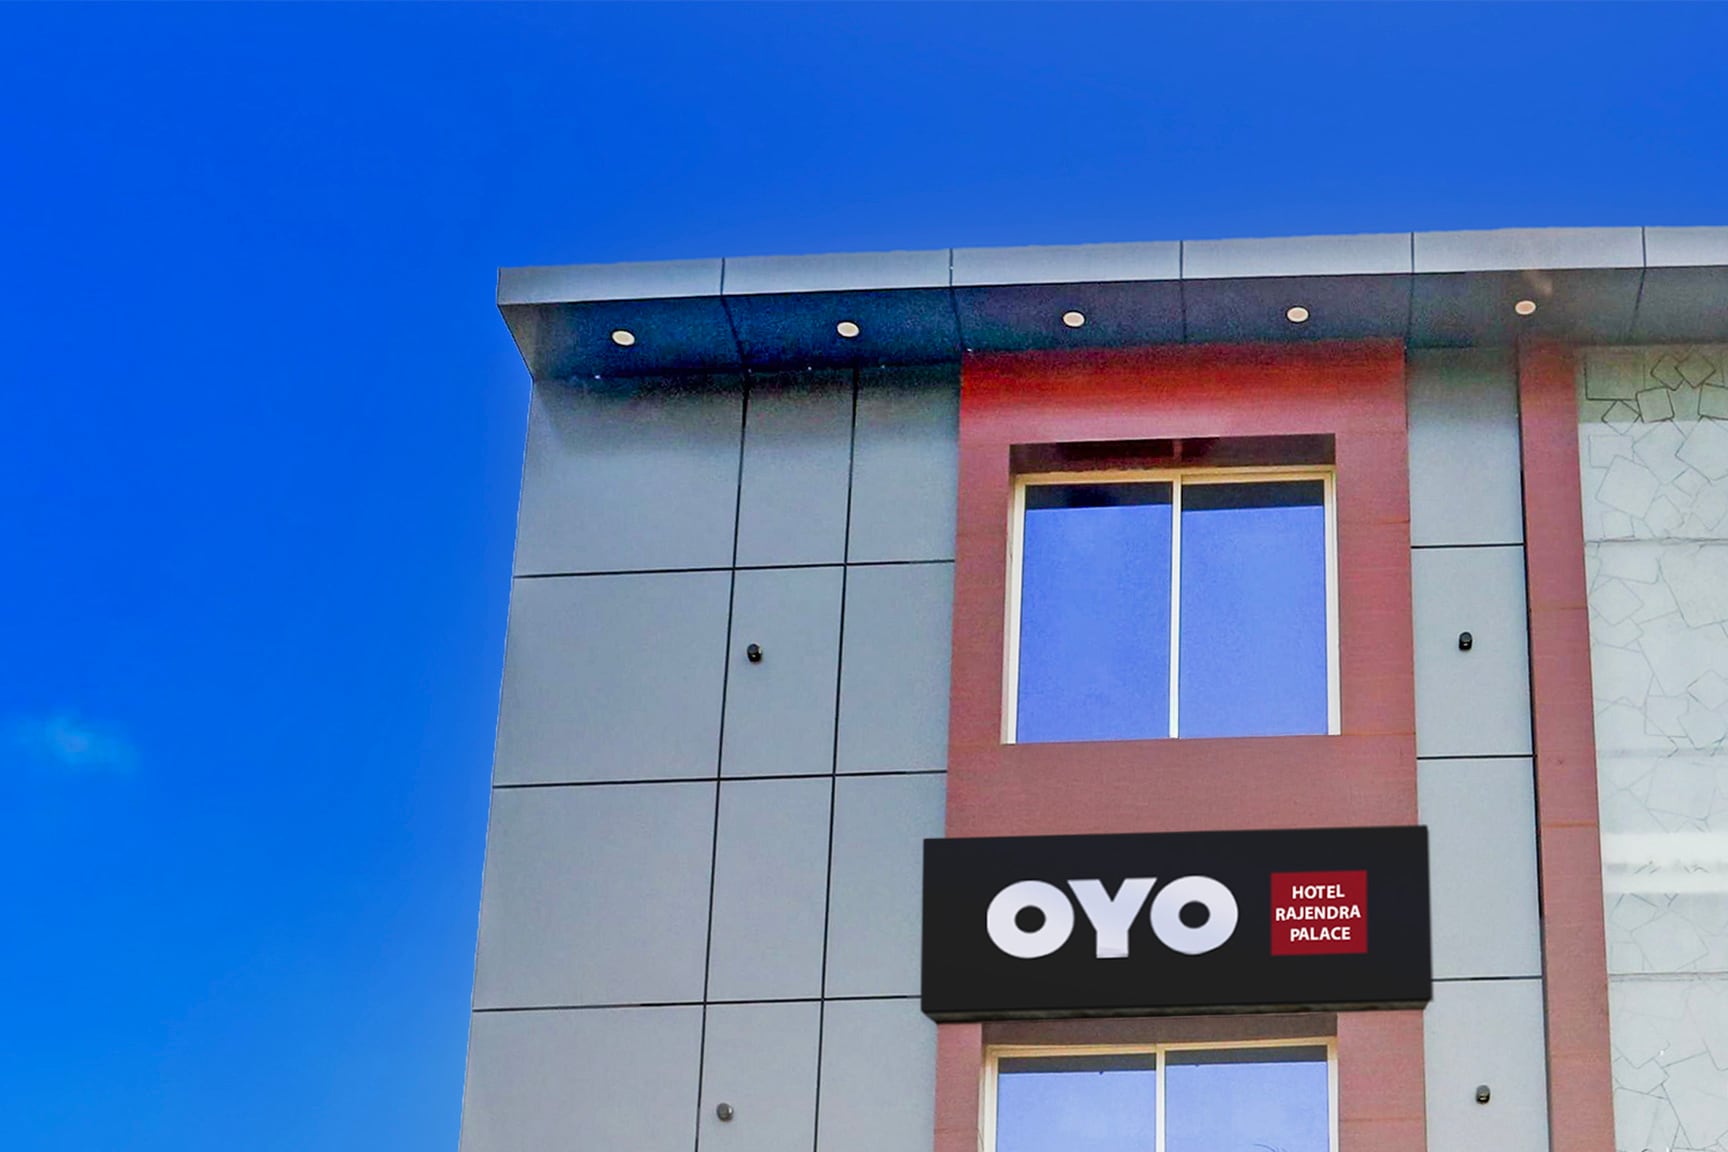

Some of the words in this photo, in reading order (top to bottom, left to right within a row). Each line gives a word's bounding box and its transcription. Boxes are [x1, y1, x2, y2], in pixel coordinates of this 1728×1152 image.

[1291, 884, 1346, 900] HOTEL
[986, 875, 1238, 959] OYO
[1274, 904, 1362, 922] RAJENDRA
[1289, 926, 1352, 942] PALACE
